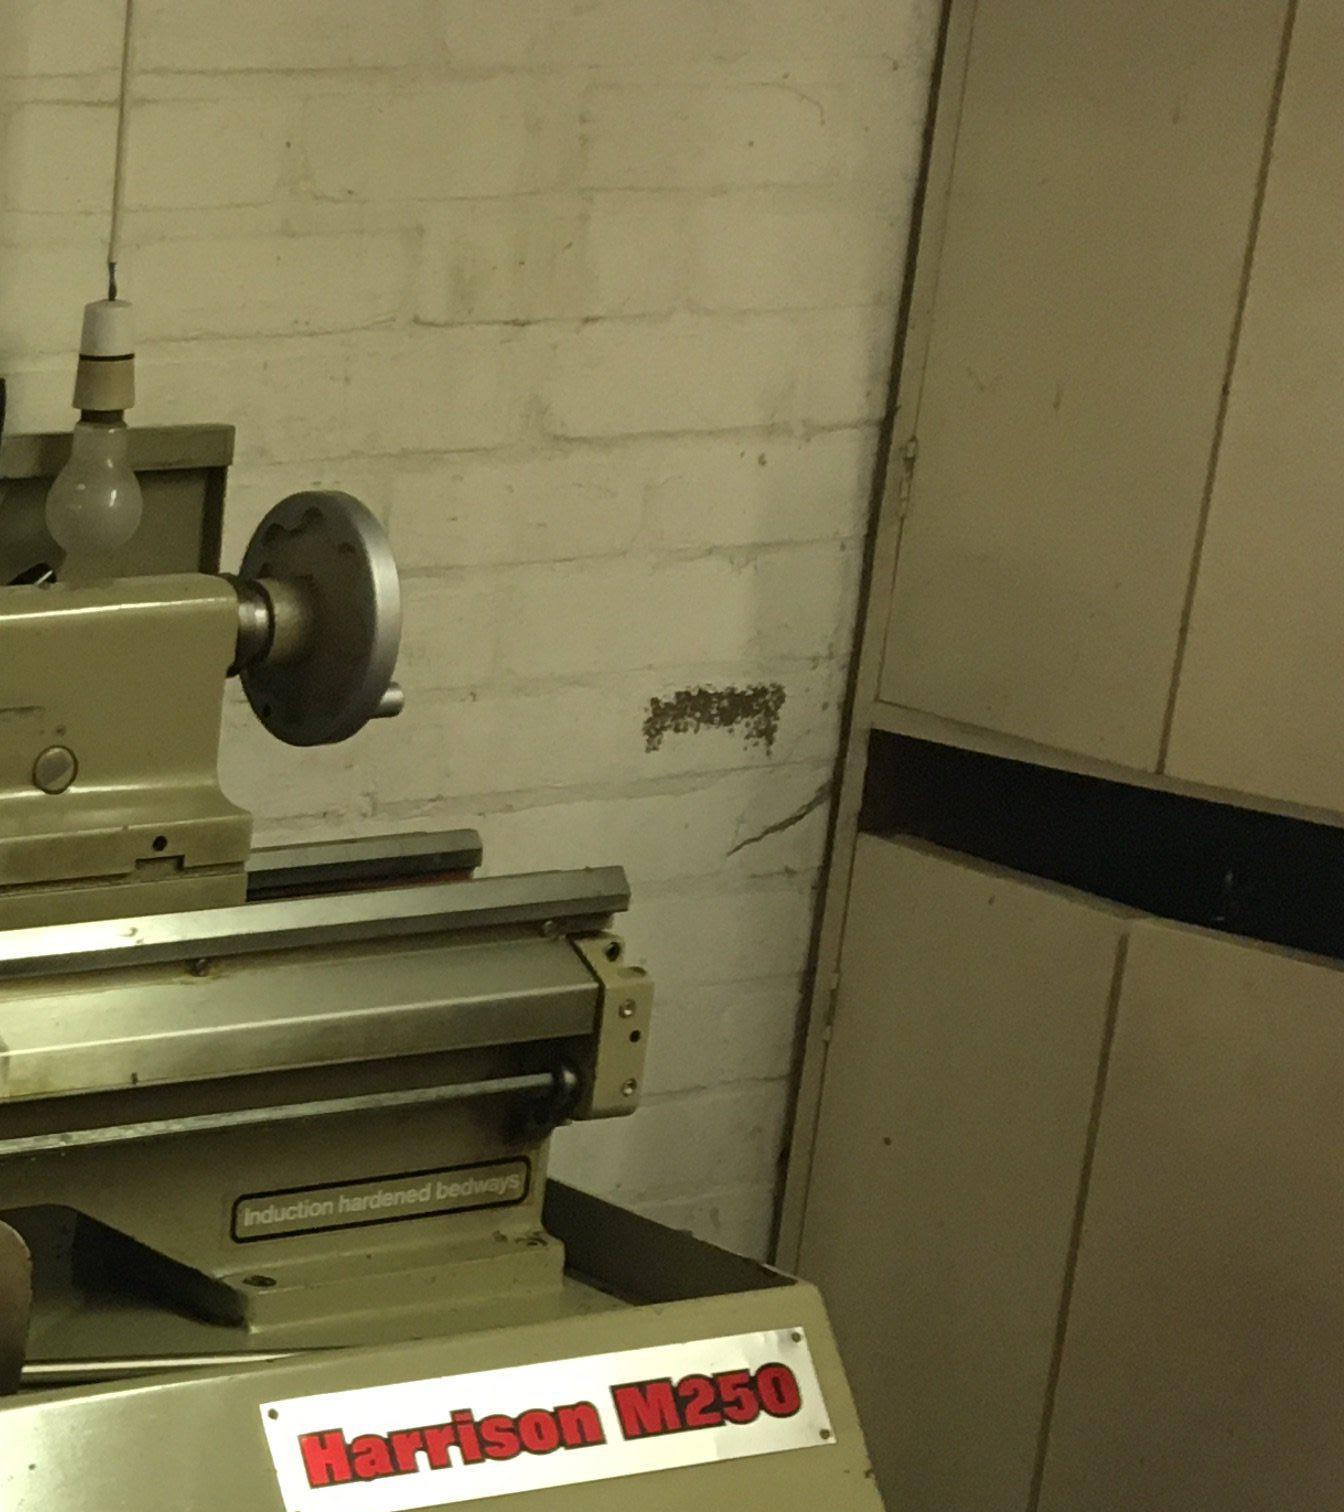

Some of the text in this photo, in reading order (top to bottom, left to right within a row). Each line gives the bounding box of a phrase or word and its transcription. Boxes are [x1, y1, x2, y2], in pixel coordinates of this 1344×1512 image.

[338, 1183, 430, 1213] hardened
[436, 1173, 520, 1200] bedways
[299, 1362, 802, 1489] Harrison M250
